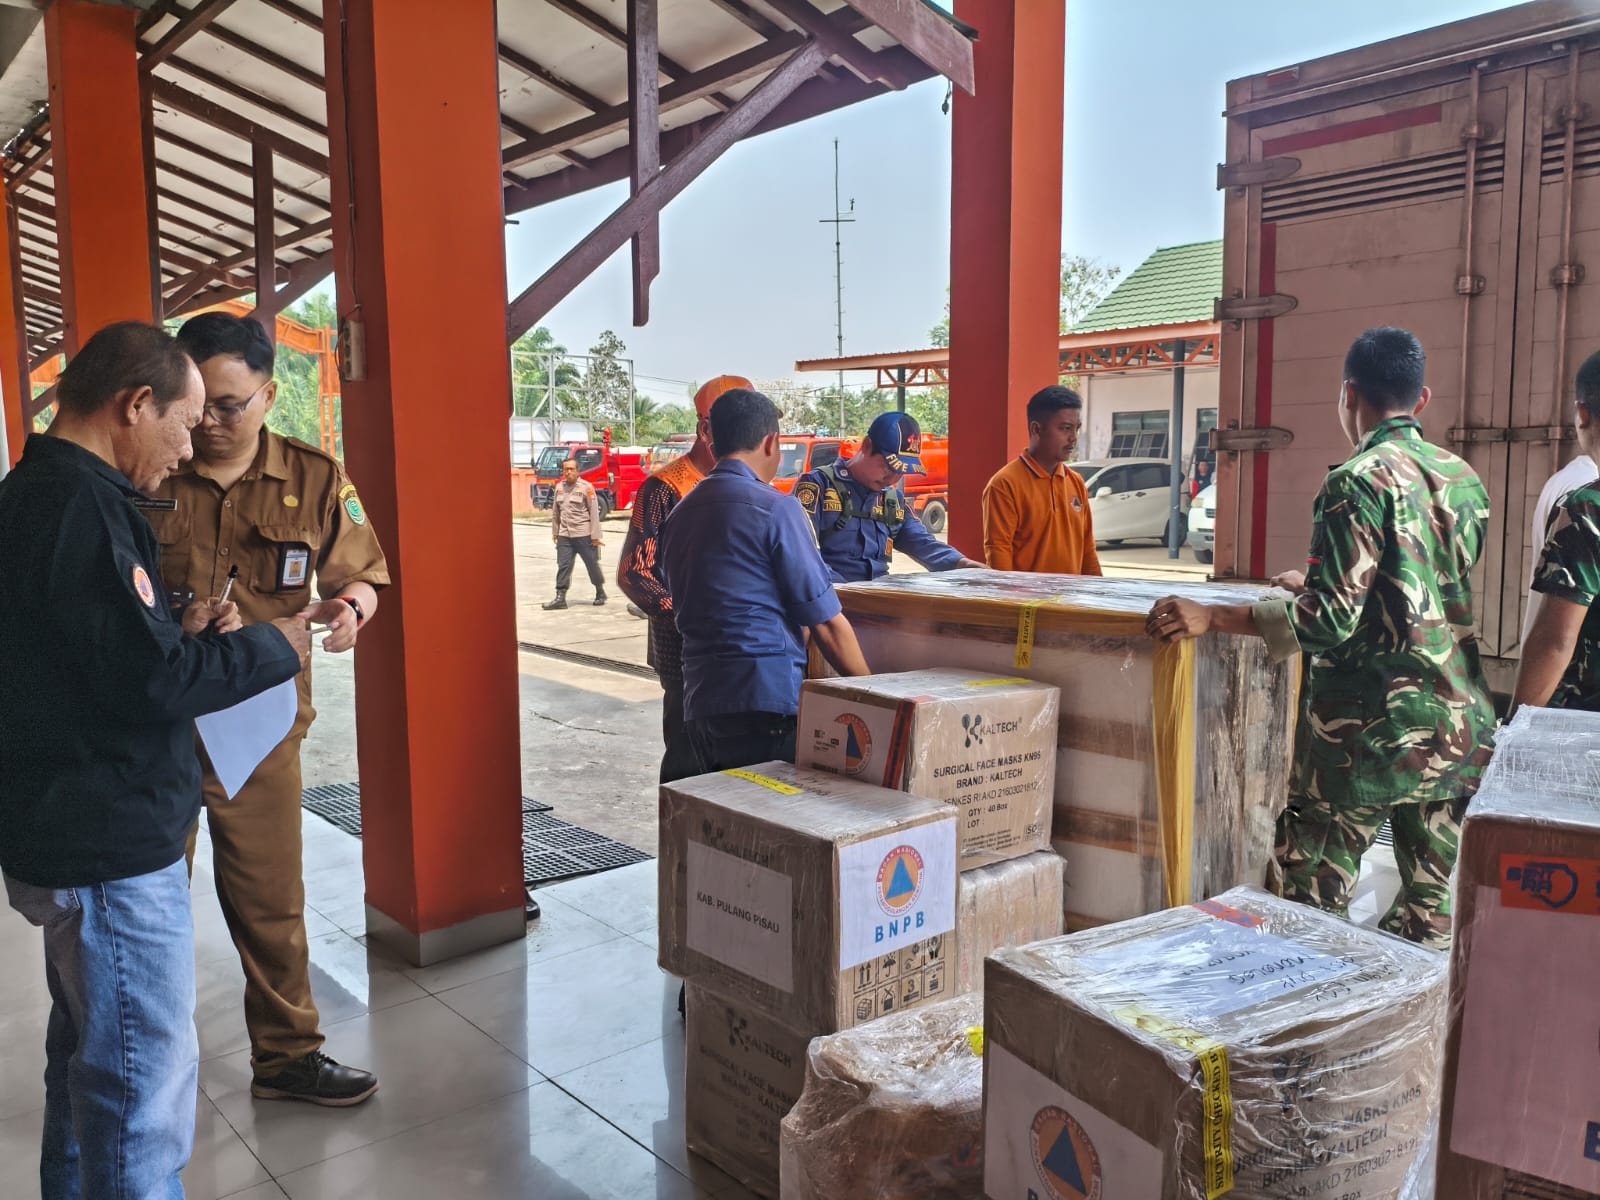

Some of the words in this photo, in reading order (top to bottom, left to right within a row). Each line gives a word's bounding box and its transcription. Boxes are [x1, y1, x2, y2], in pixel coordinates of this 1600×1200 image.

[885, 453, 908, 472] FIRE
[980, 721, 1018, 735] KALTECH
[933, 762, 974, 778] SURGICAL
[976, 758, 996, 772] FACE
[997, 754, 1022, 767] MASKS
[1024, 750, 1041, 761] KN95
[956, 776, 983, 789] BRAND
[990, 768, 1023, 783] KALTECH
[967, 819, 980, 829] LOT
[968, 807, 981, 817] QTY
[696, 890, 715, 907] KAB.
[716, 899, 752, 922] PULANG
[753, 914, 780, 933] PISAU
[874, 911, 925, 944] BNPB
[1212, 1064, 1224, 1127] CHECKED
[1392, 1084, 1422, 1109] KN95
[1212, 1128, 1224, 1190] SECURITY
